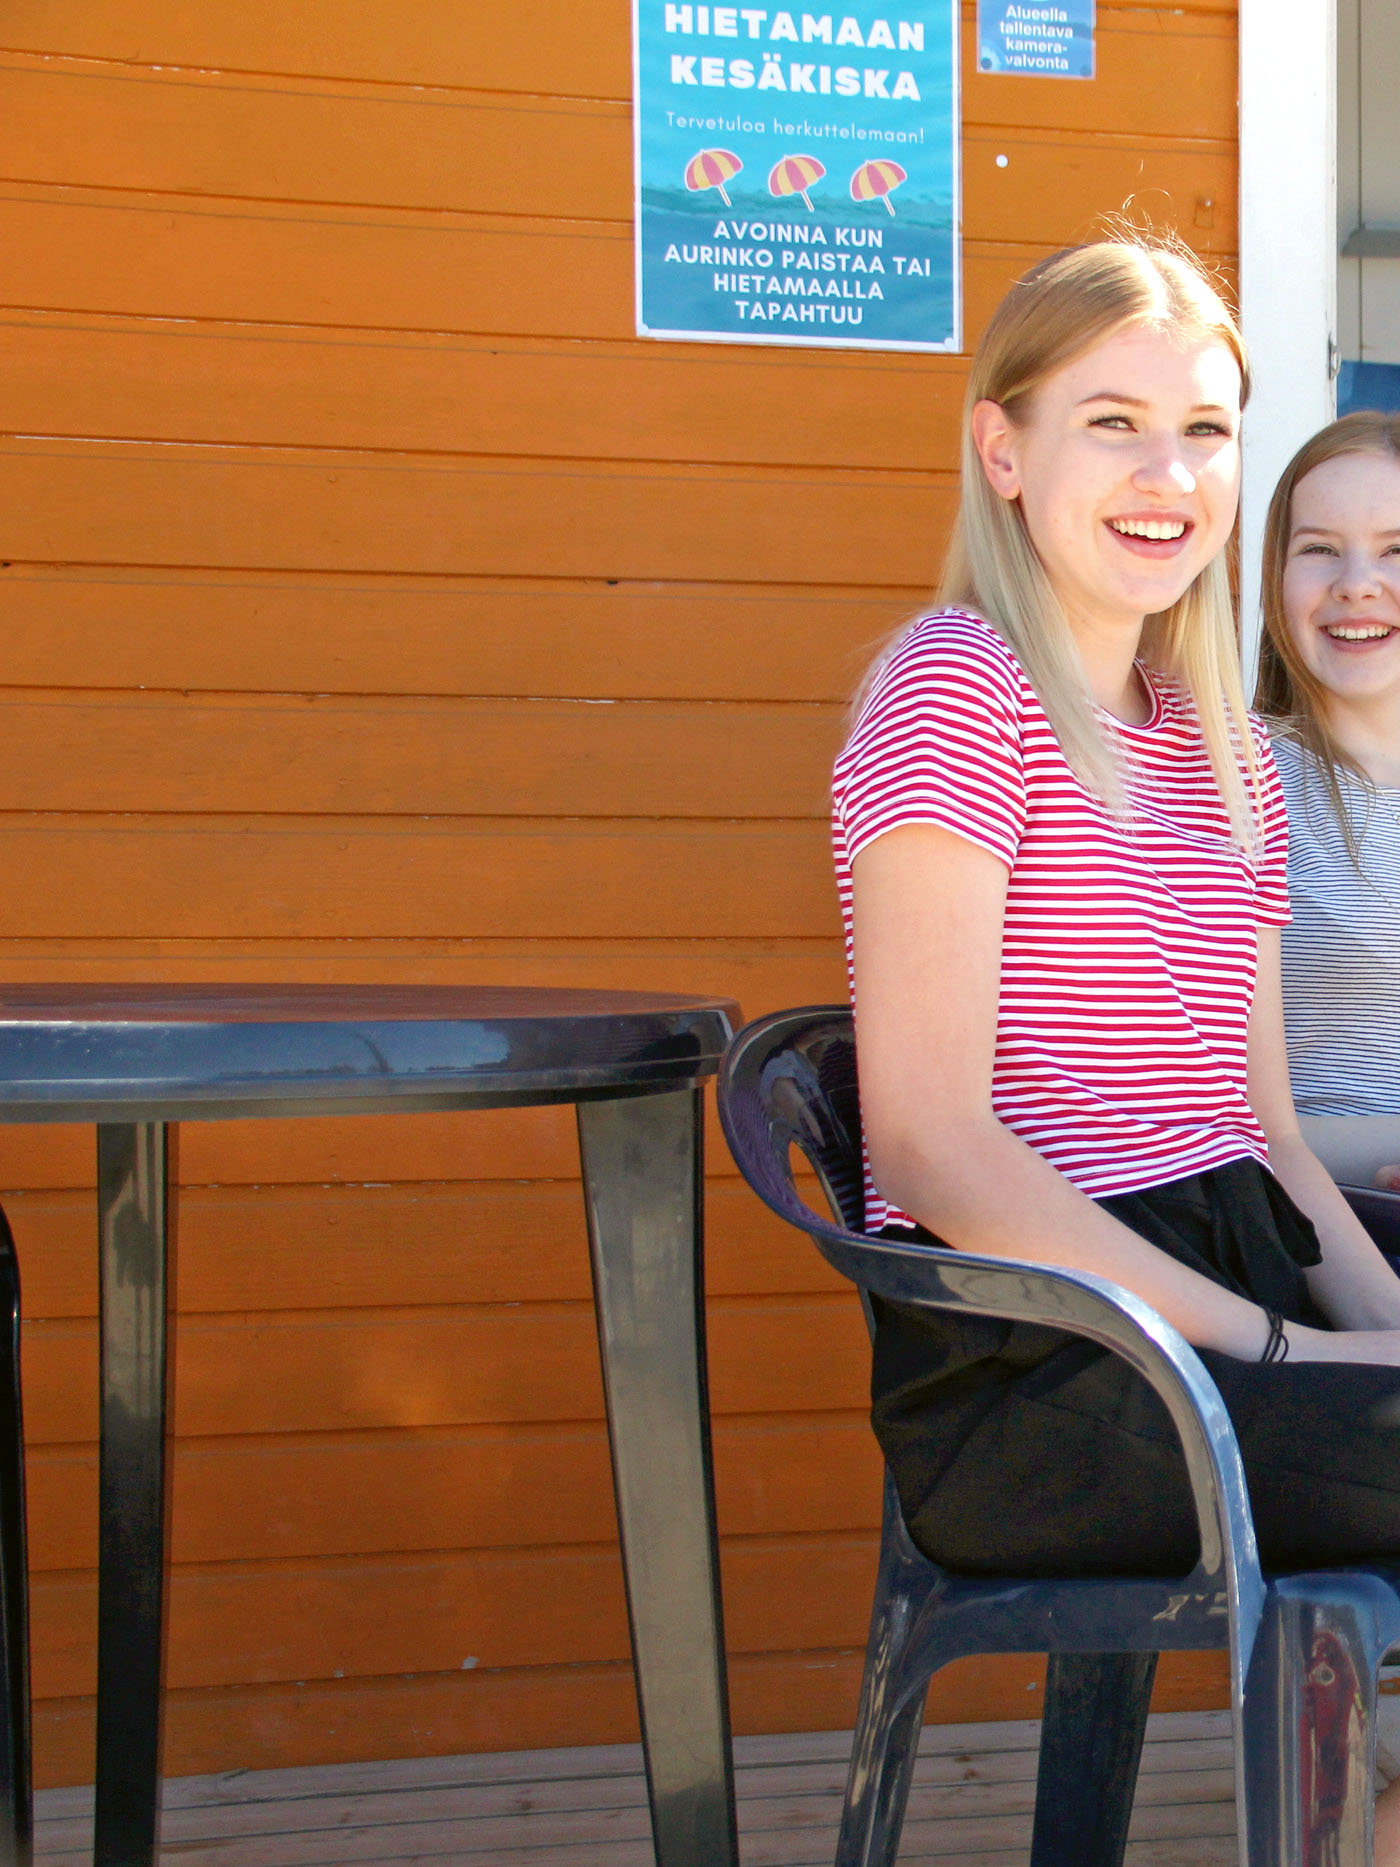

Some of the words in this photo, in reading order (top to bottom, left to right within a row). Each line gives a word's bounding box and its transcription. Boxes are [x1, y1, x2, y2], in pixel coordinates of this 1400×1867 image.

[1006, 5, 1068, 22] Alueella
[665, 3, 925, 52] HIETAMAAN
[1000, 21, 1073, 39] tallentava
[1006, 37, 1068, 54] kamera-
[1005, 54, 1069, 70] valvonta
[671, 53, 921, 101] KESÄKISKA
[666, 111, 766, 133] Tervetuloa
[773, 118, 924, 144] herkuttelemaan!
[714, 221, 827, 245] AVOINNA
[835, 227, 883, 248] KUN
[664, 244, 774, 269] AURINKO
[782, 251, 885, 274] PAISTAA
[893, 257, 930, 276] TAI
[713, 273, 884, 300] HIETAMAALLA
[735, 301, 863, 325] TAPAHTUU
